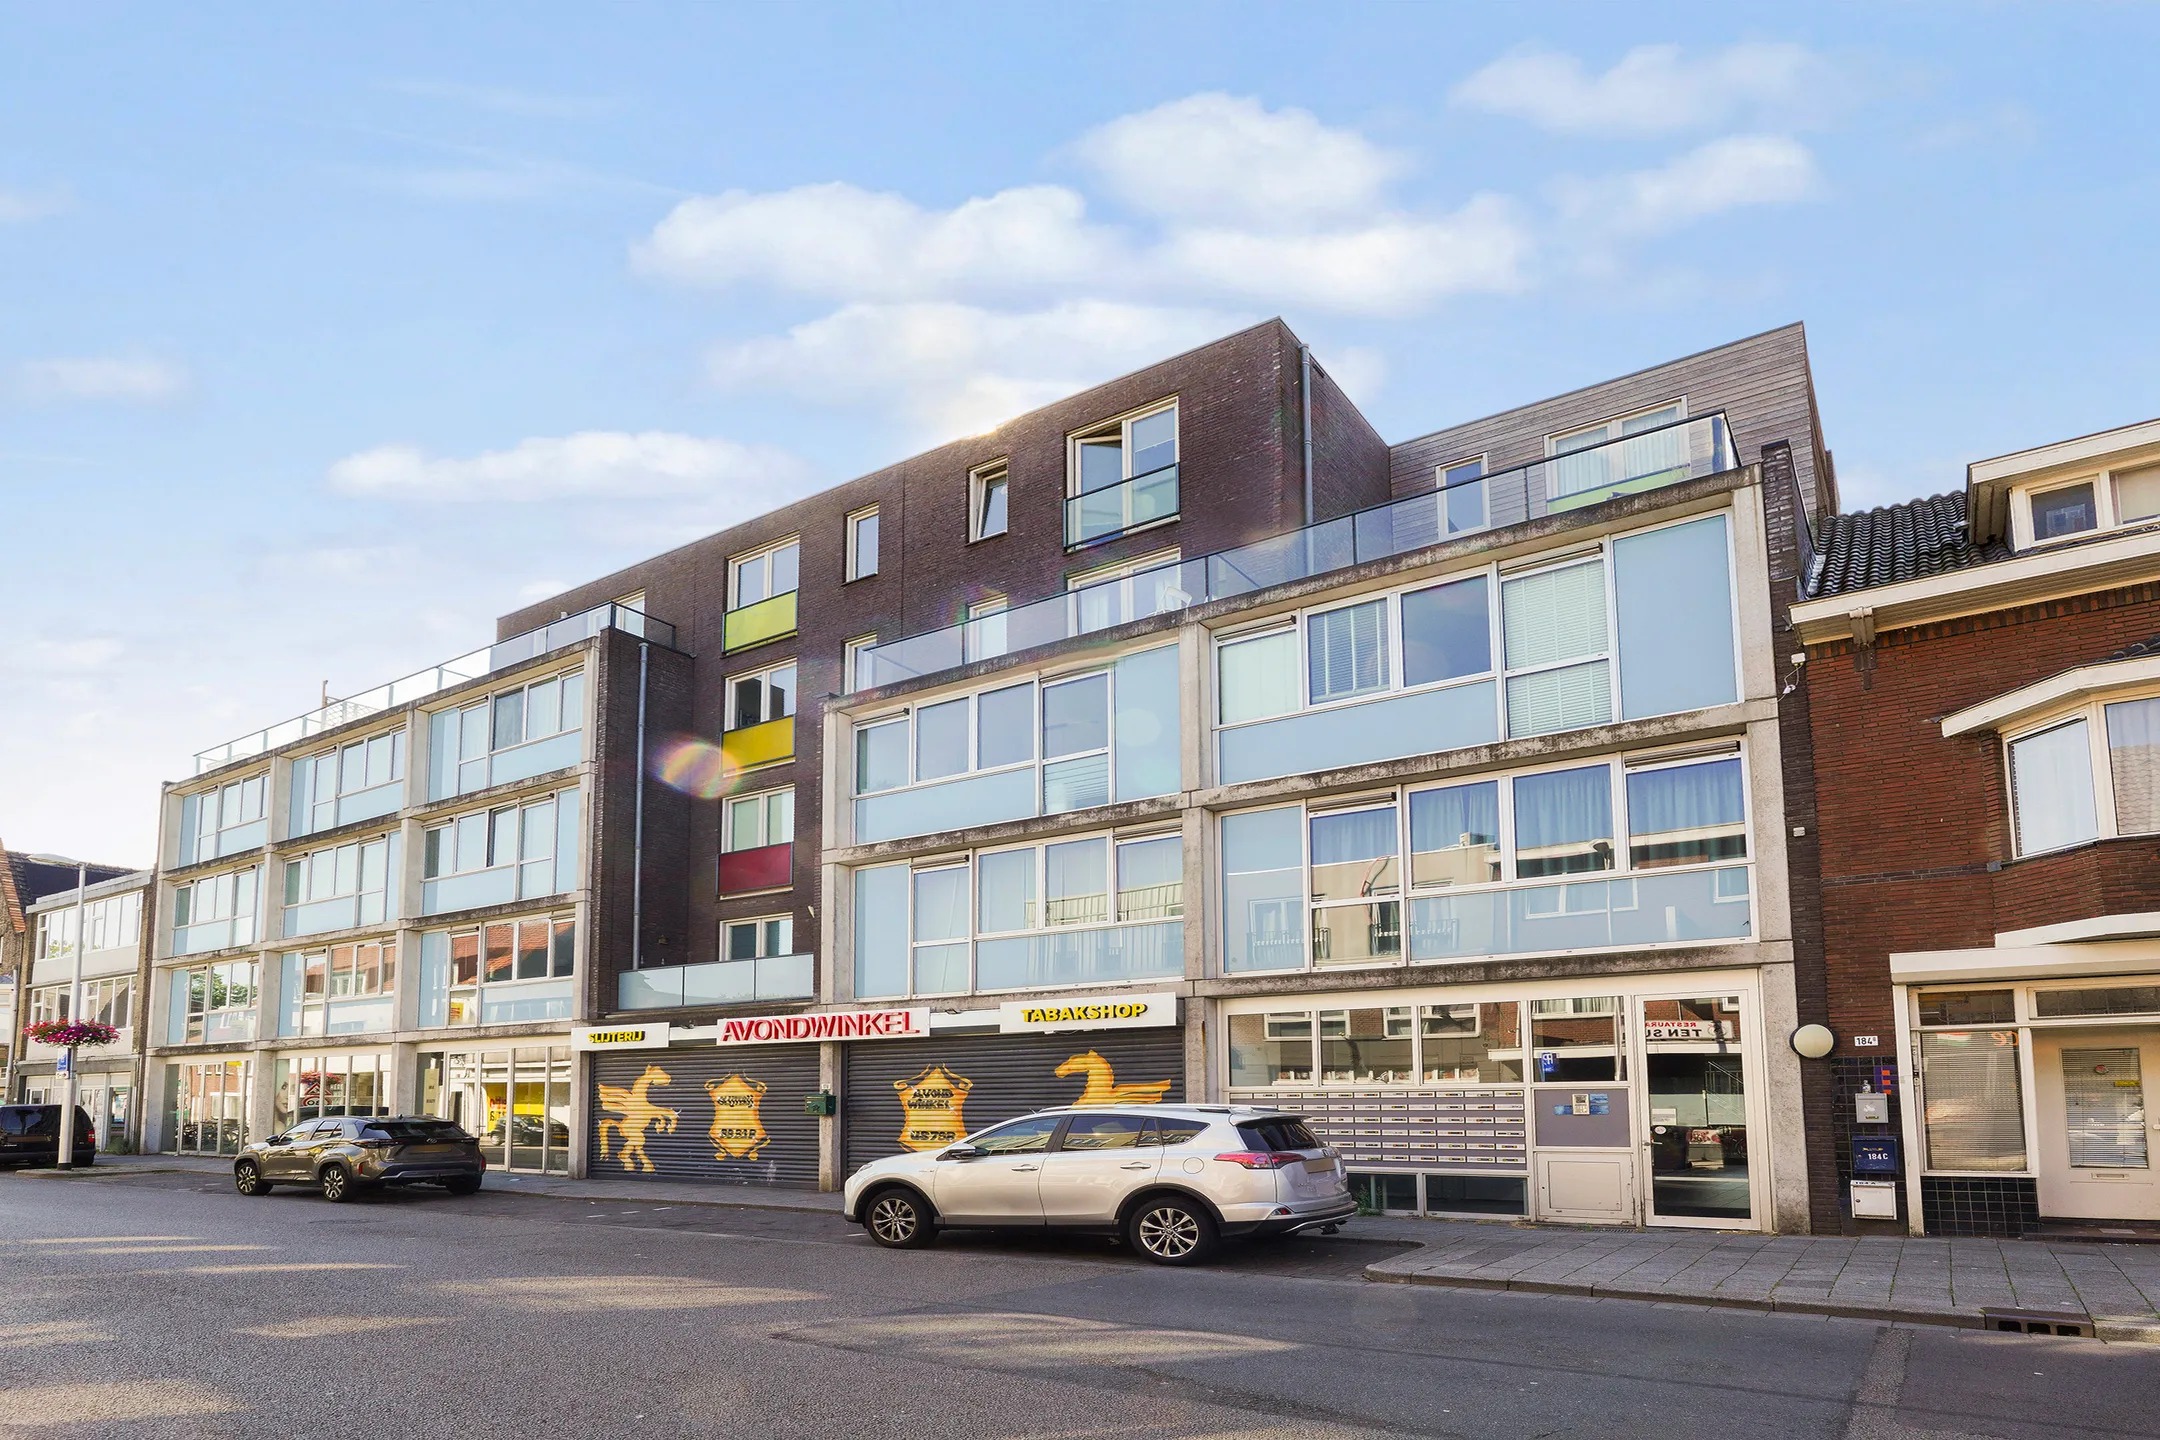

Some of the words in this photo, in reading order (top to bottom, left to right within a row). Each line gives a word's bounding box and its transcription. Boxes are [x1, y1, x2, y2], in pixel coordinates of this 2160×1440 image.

[1020, 1003, 1148, 1023] TABAKSHOP
[722, 1011, 921, 1042] AVONDWINKEL
[588, 1031, 646, 1043] SLIJTERIJ
